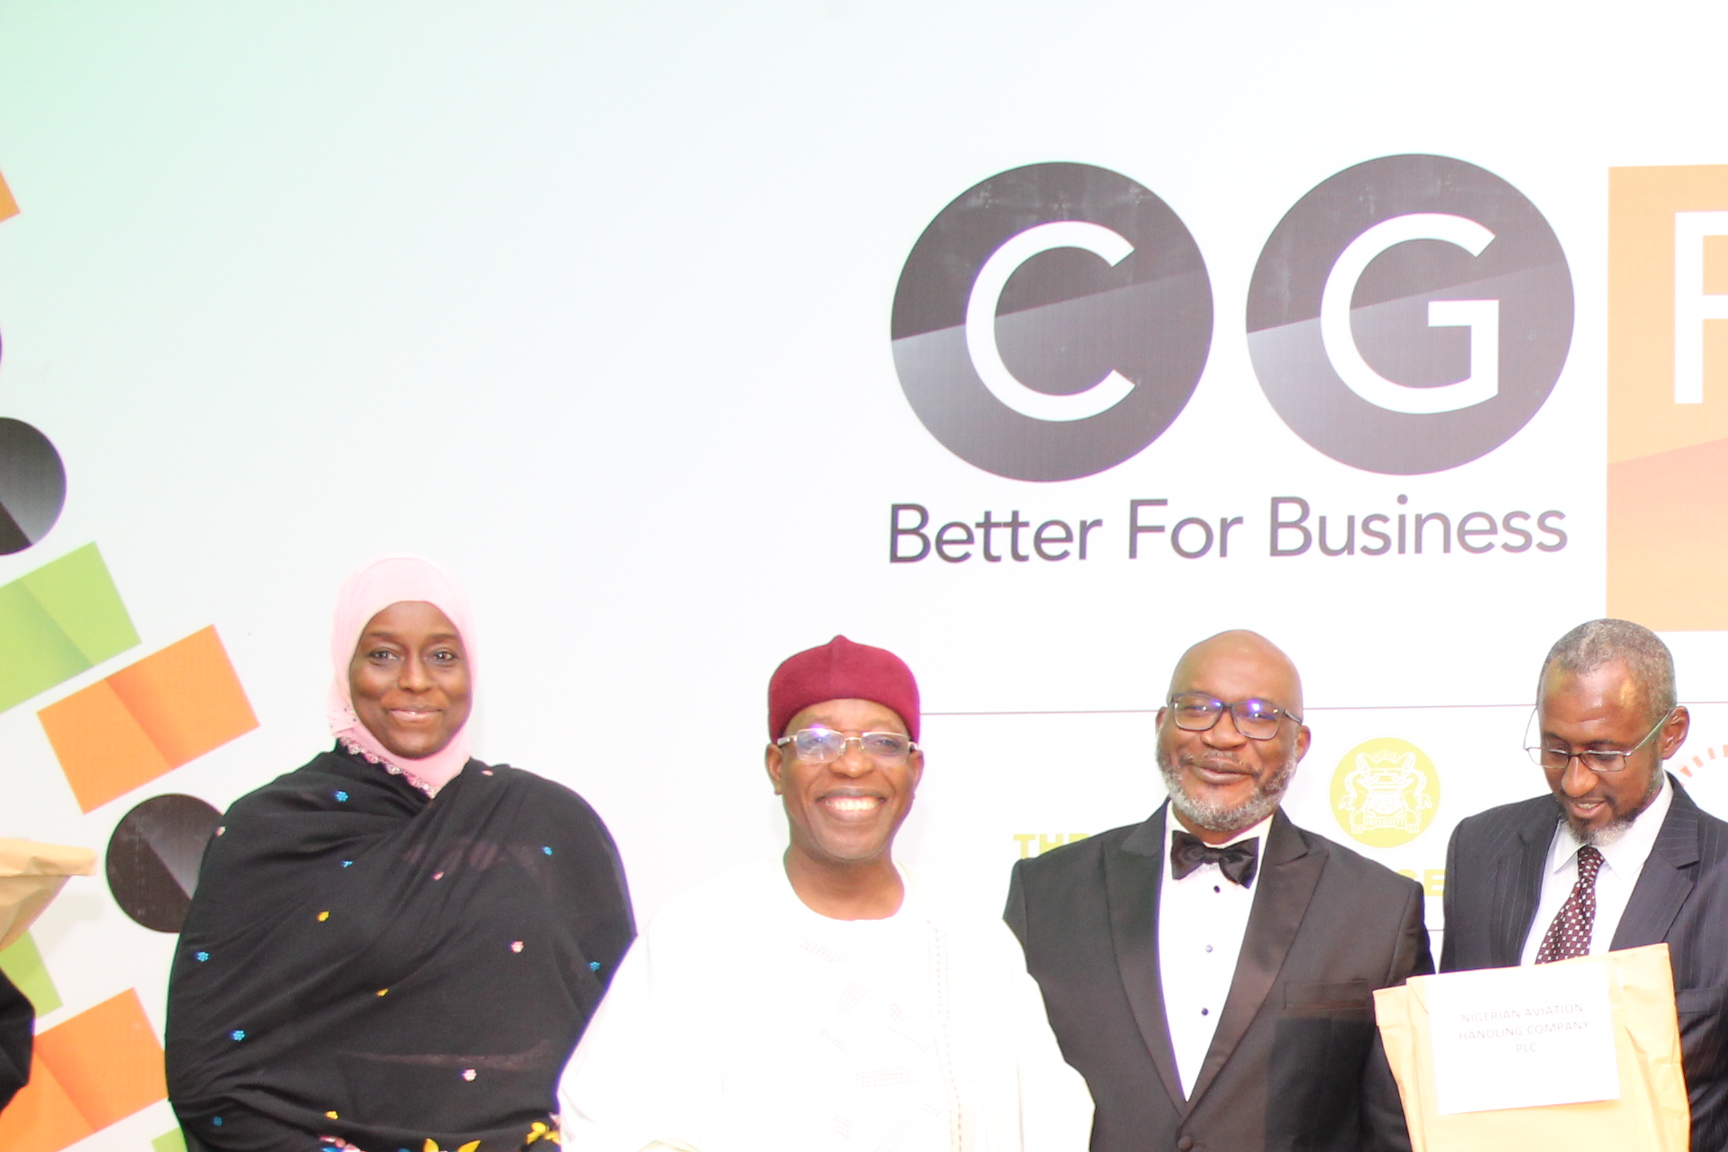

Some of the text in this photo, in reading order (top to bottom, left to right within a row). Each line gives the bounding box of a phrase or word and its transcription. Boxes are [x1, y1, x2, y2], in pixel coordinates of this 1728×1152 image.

[889, 494, 1568, 564] Better For Business
[1461, 1003, 1583, 1023] NIGERIAN AVIATION
[1459, 1020, 1589, 1040] HANDLING COMPANY
[1516, 1042, 1537, 1053] PLC
